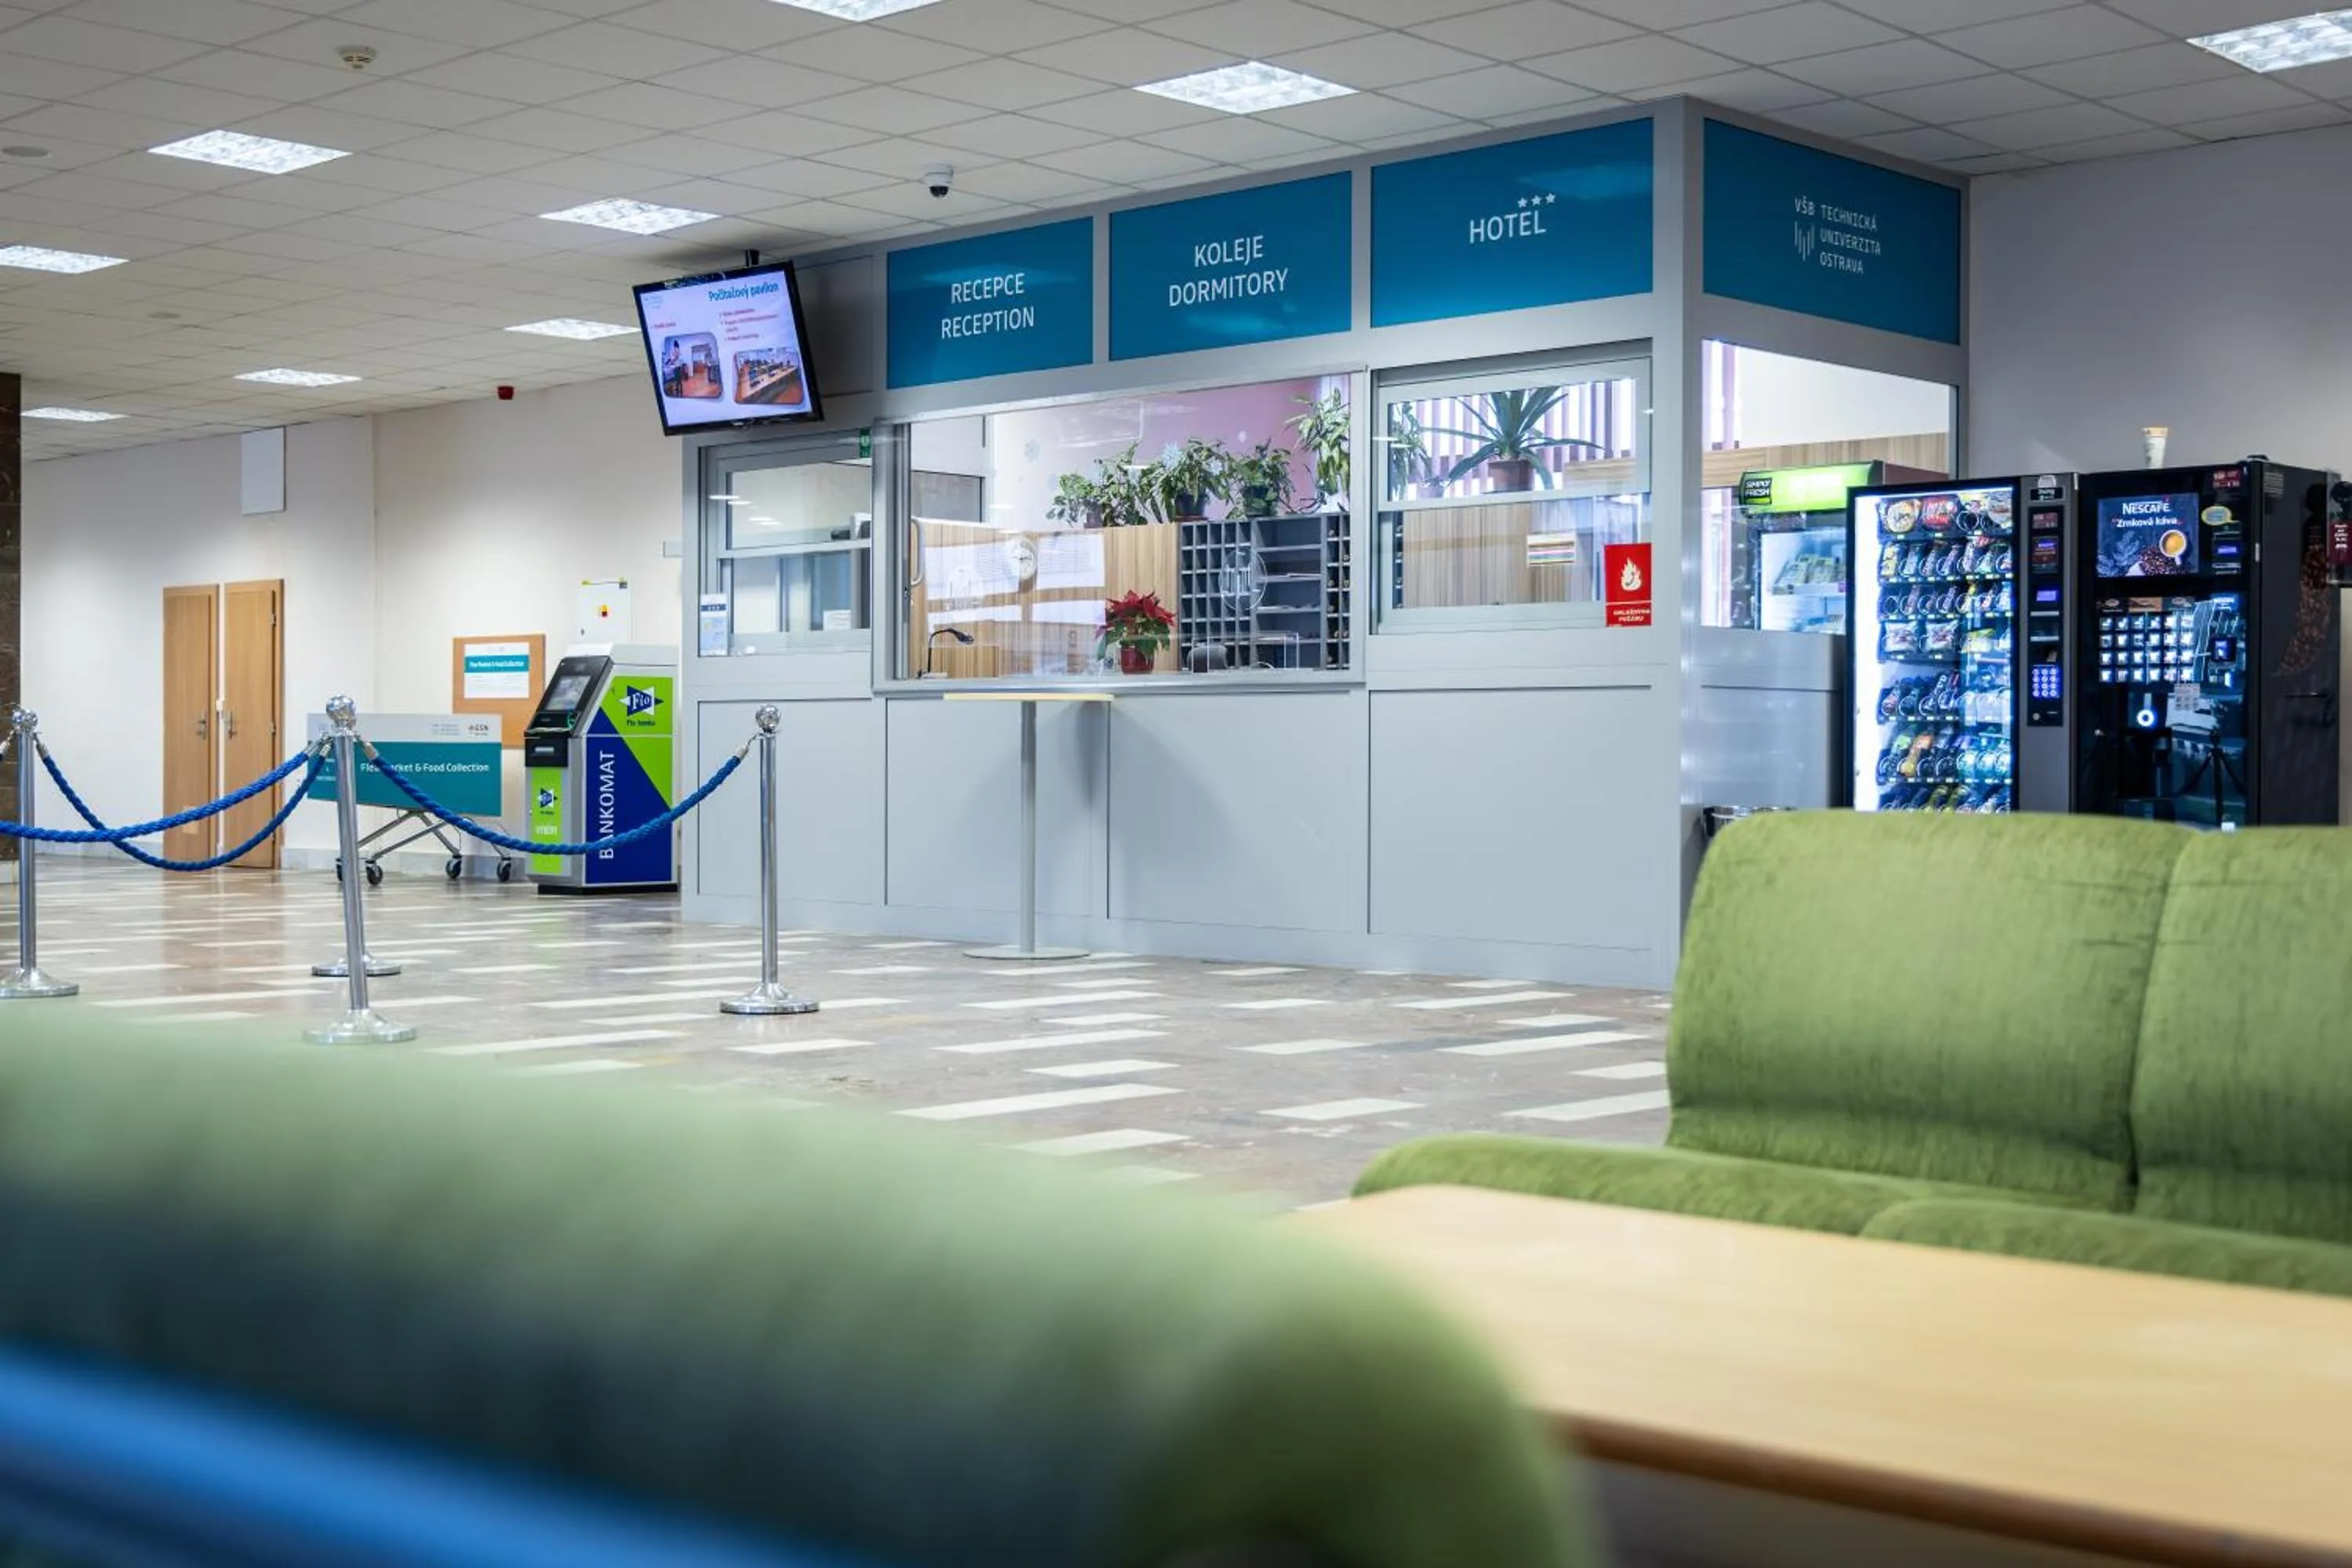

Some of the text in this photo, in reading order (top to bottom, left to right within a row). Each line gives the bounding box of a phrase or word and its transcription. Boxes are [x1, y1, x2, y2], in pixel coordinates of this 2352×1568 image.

[1470, 209, 1547, 244] HOTEL
[1795, 195, 1877, 232] VŠB TECHNICKÁ
[1194, 234, 1264, 267] KOLEJE
[1820, 227, 1881, 256] UNIVERZITA
[1820, 252, 1864, 274] OSTRAVA
[951, 272, 1025, 304] RECEPCE
[1169, 267, 1289, 307] DORMITORY
[941, 306, 1034, 339] RECEPTION
[632, 692, 650, 710] Fio
[415, 763, 422, 772] &
[423, 763, 445, 772] Food
[446, 763, 490, 772] Collection
